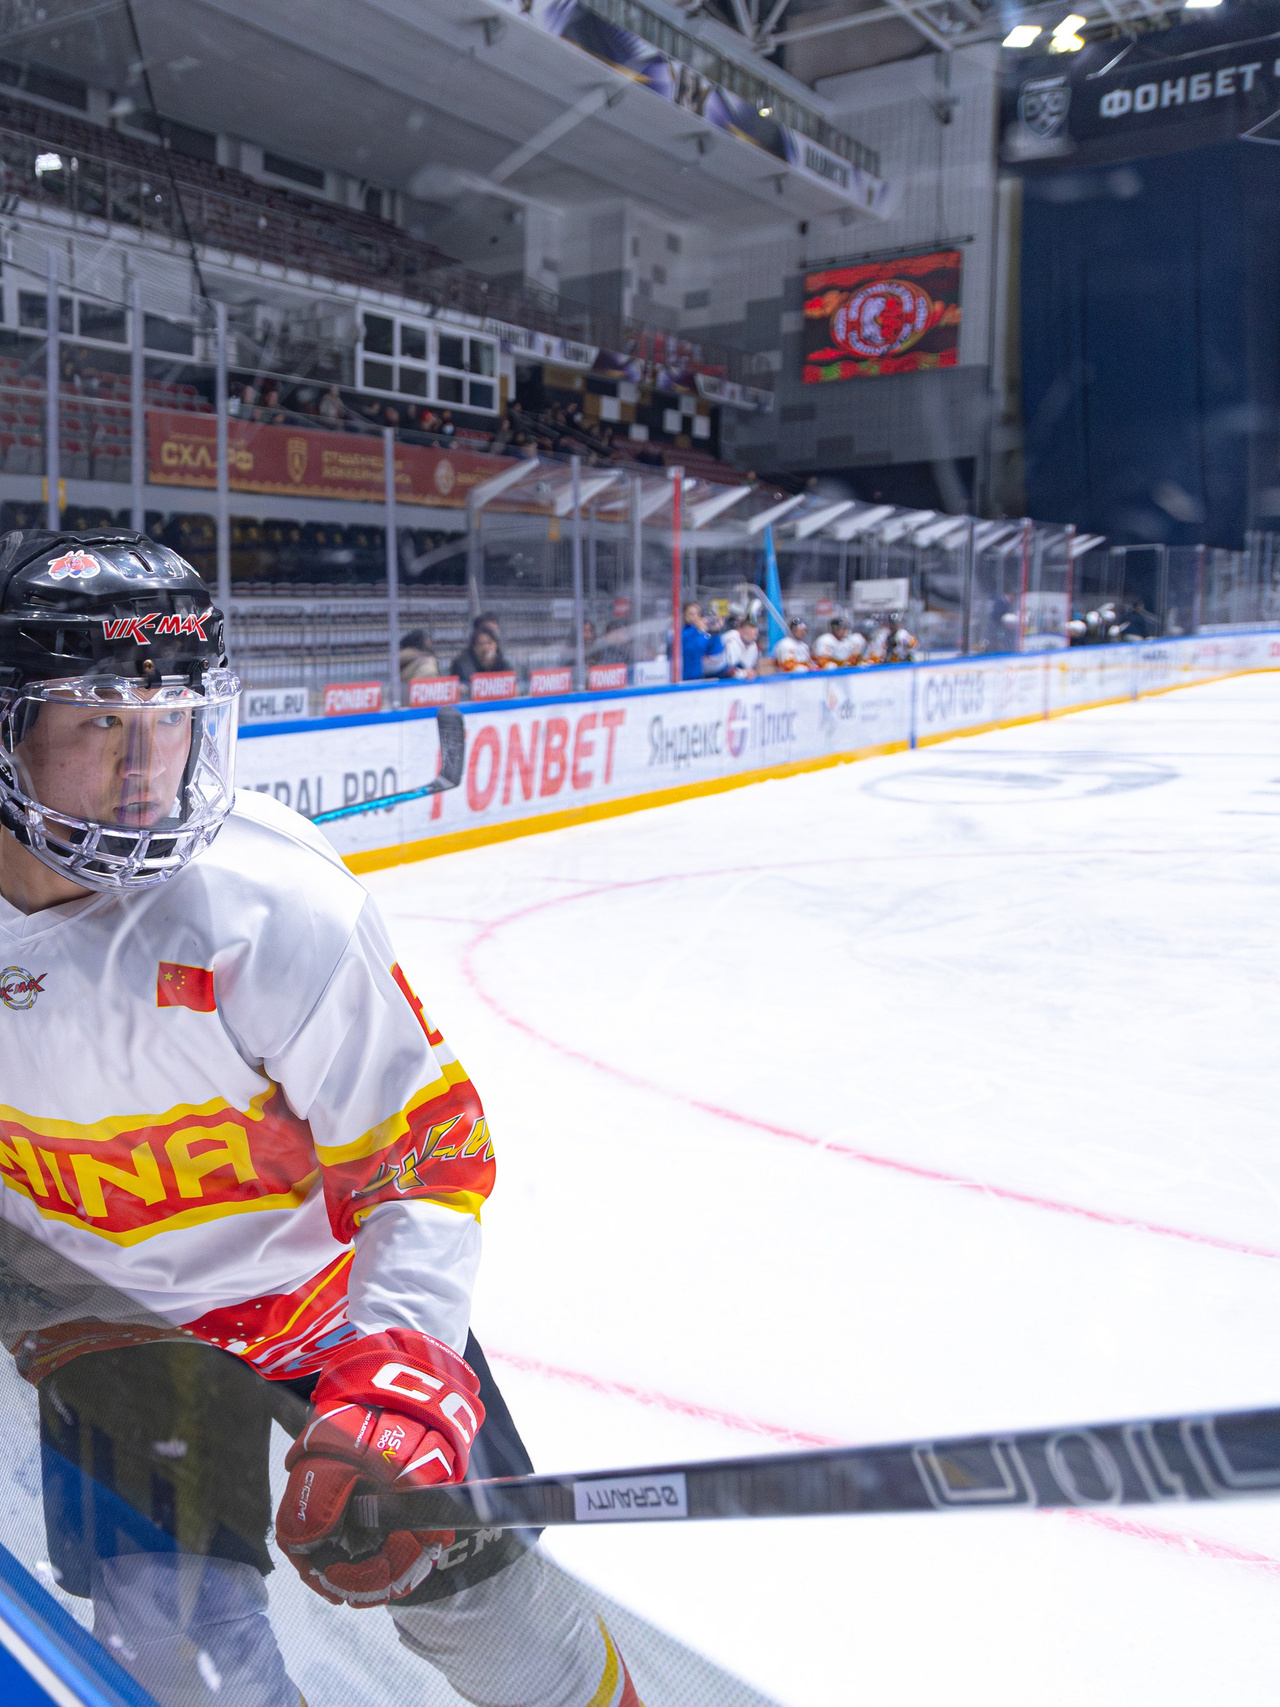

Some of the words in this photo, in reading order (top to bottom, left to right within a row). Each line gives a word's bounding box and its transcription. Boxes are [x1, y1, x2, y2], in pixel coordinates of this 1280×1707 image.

[1099, 61, 1263, 119] ФОНБЕТ
[102, 612, 214, 646] VIK-MAX
[412, 681, 458, 705] FONBET
[473, 674, 515, 697] FONBET
[248, 693, 305, 718] KHL.RU
[326, 686, 381, 713] FONBET
[648, 715, 723, 768] Яндекс
[376, 1429, 392, 1449] PRO
[298, 1470, 314, 1522] CCM
